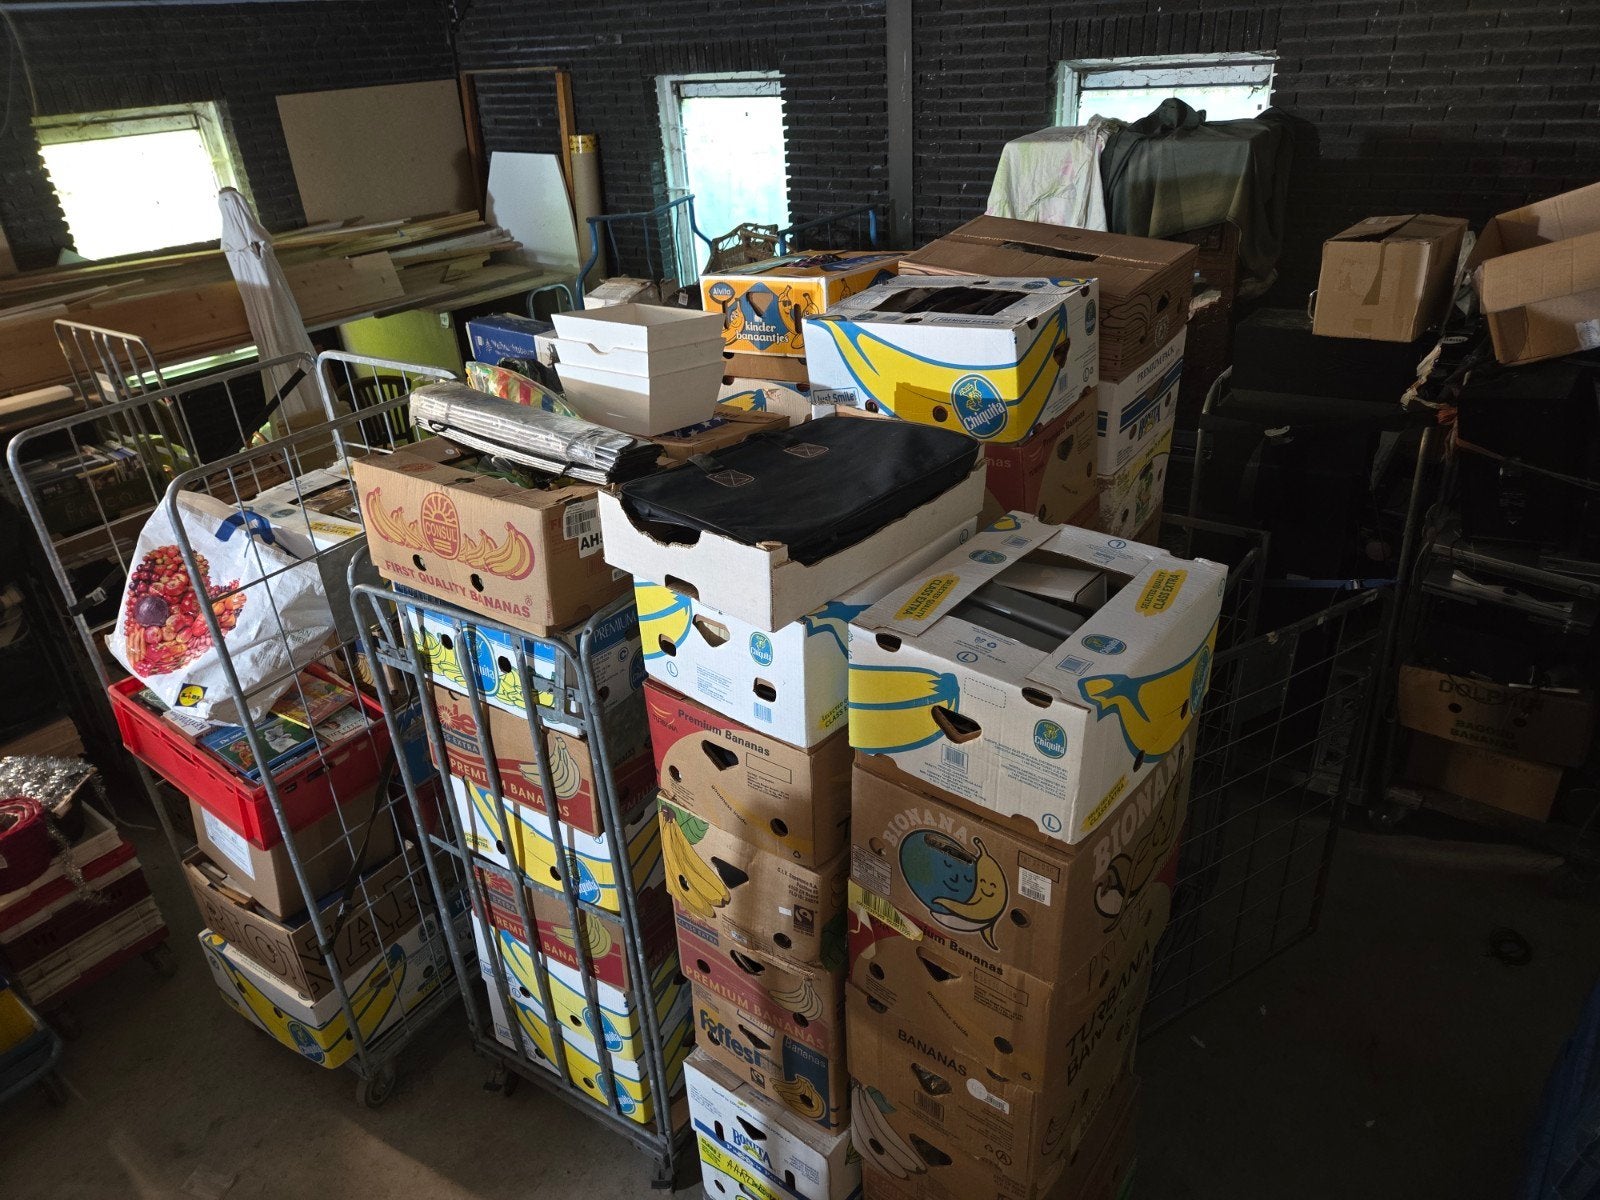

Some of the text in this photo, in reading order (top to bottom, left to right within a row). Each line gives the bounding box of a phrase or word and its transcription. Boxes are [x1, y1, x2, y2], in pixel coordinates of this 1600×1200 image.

[736, 332, 789, 345] banaantjes
[745, 321, 776, 332] kinder
[964, 402, 1006, 431] Chiquita
[425, 520, 458, 542] CONSUL
[385, 560, 530, 619] FIRST QUALITY BANANAS
[1153, 574, 1180, 610] CLASS EXTRA
[594, 611, 637, 643] PREMIUM
[678, 709, 722, 735] Premium
[725, 729, 770, 756] Bananas
[1034, 735, 1065, 754] Chiquita
[450, 758, 507, 791] PREMIM
[882, 807, 968, 847] BIONANA
[1047, 816, 1055, 829] L
[950, 941, 1003, 976] Bananas
[685, 966, 825, 1050] PREMIUM BANANAS
[785, 1036, 826, 1068] Bananas
[898, 1029, 967, 1076] BANANAS
[731, 1126, 773, 1171] BONITA
